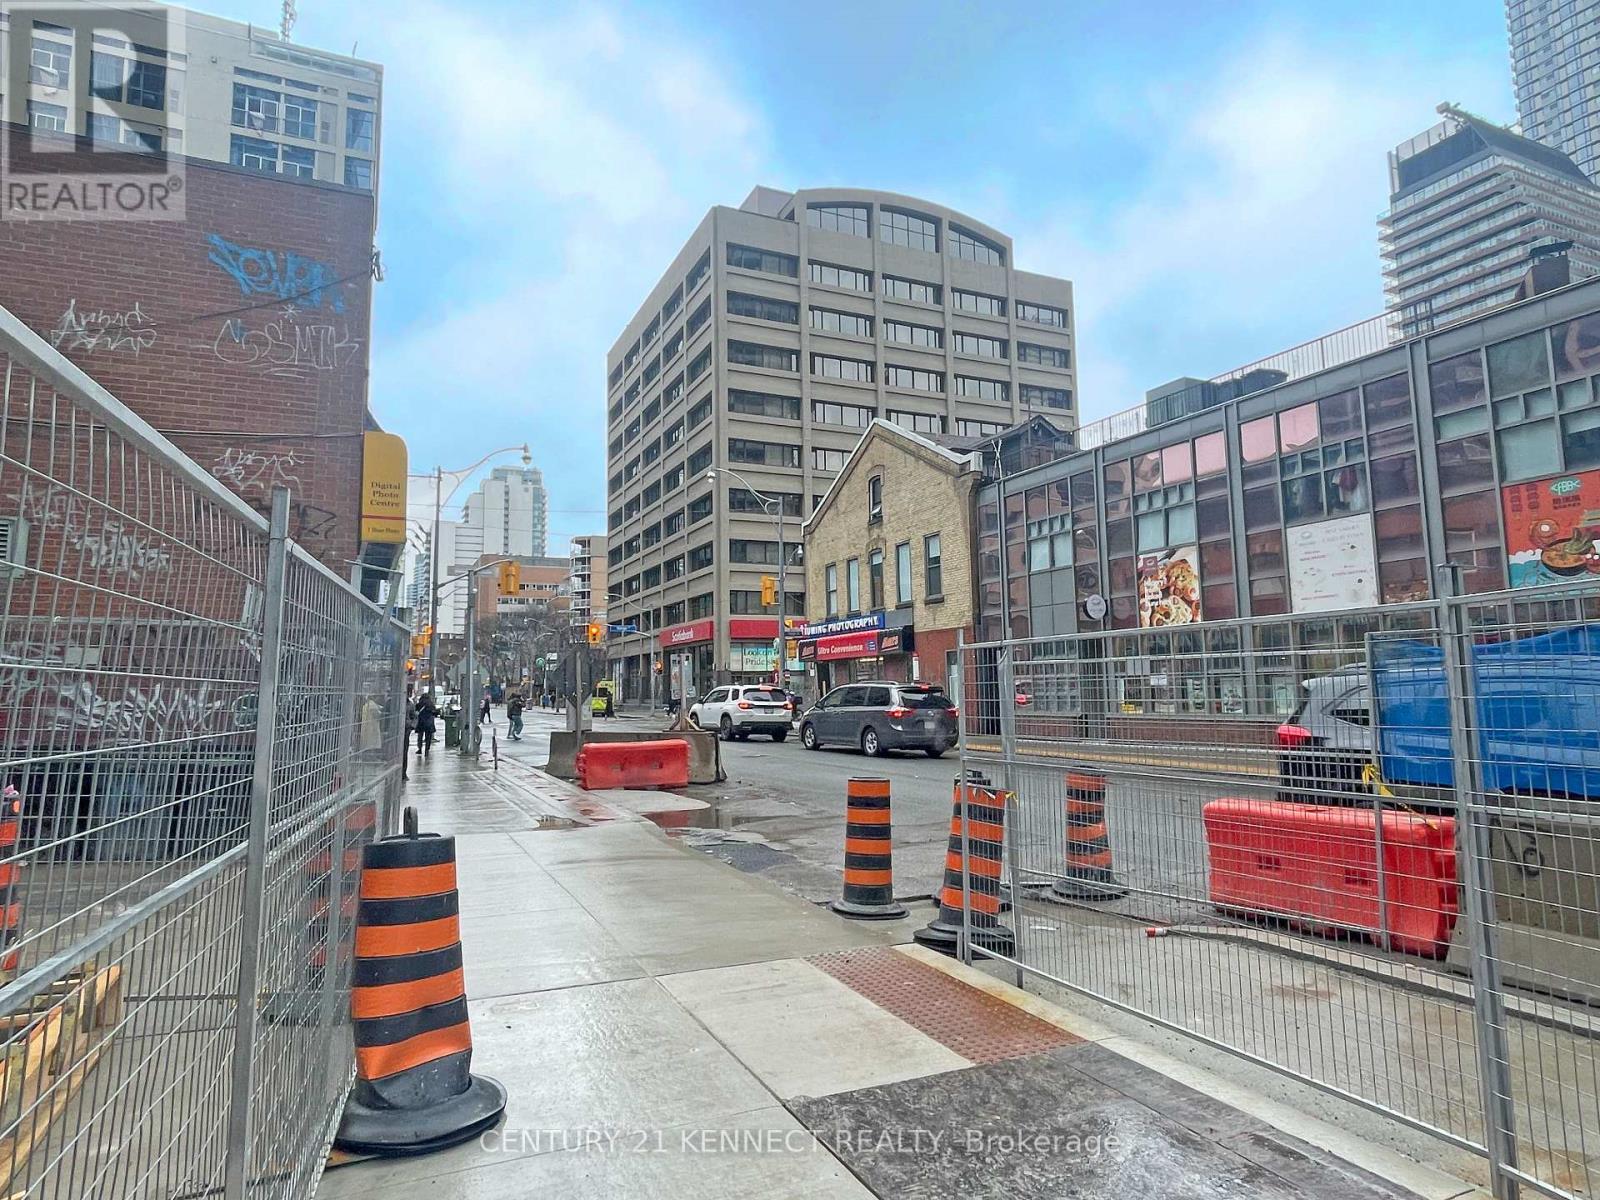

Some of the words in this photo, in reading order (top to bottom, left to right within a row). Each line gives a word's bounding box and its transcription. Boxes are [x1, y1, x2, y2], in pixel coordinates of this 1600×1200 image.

[371, 481, 400, 490] Digital
[372, 490, 400, 498] Photo
[828, 616, 879, 632] PHOTOGRAPHY
